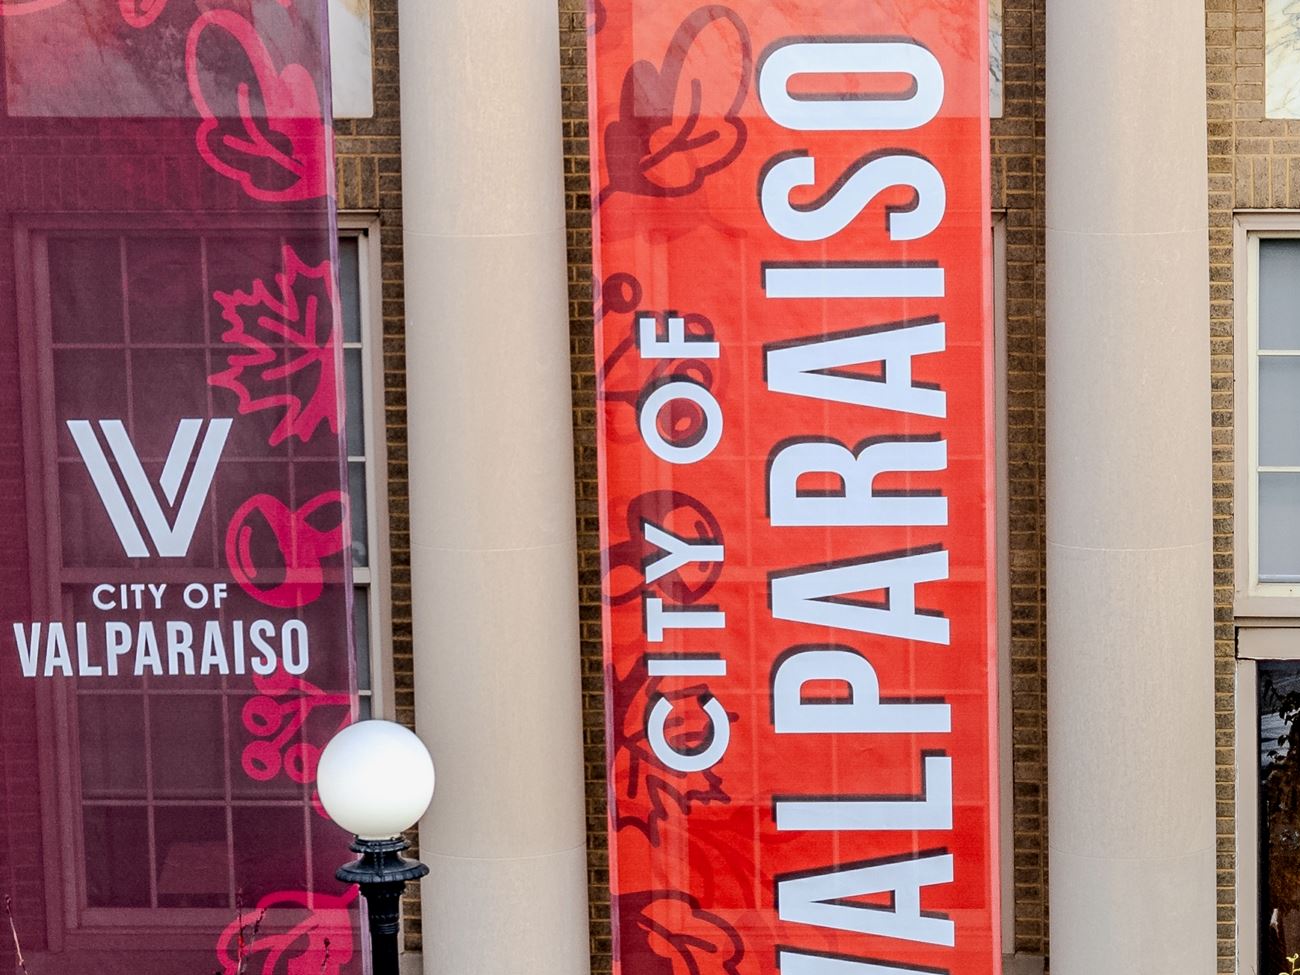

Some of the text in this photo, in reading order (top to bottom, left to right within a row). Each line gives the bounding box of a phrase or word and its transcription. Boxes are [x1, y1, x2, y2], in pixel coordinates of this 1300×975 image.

[639, 317, 730, 772] CITY OF
[92, 583, 227, 610] CITY OF
[13, 619, 309, 677] VALPARAISO
